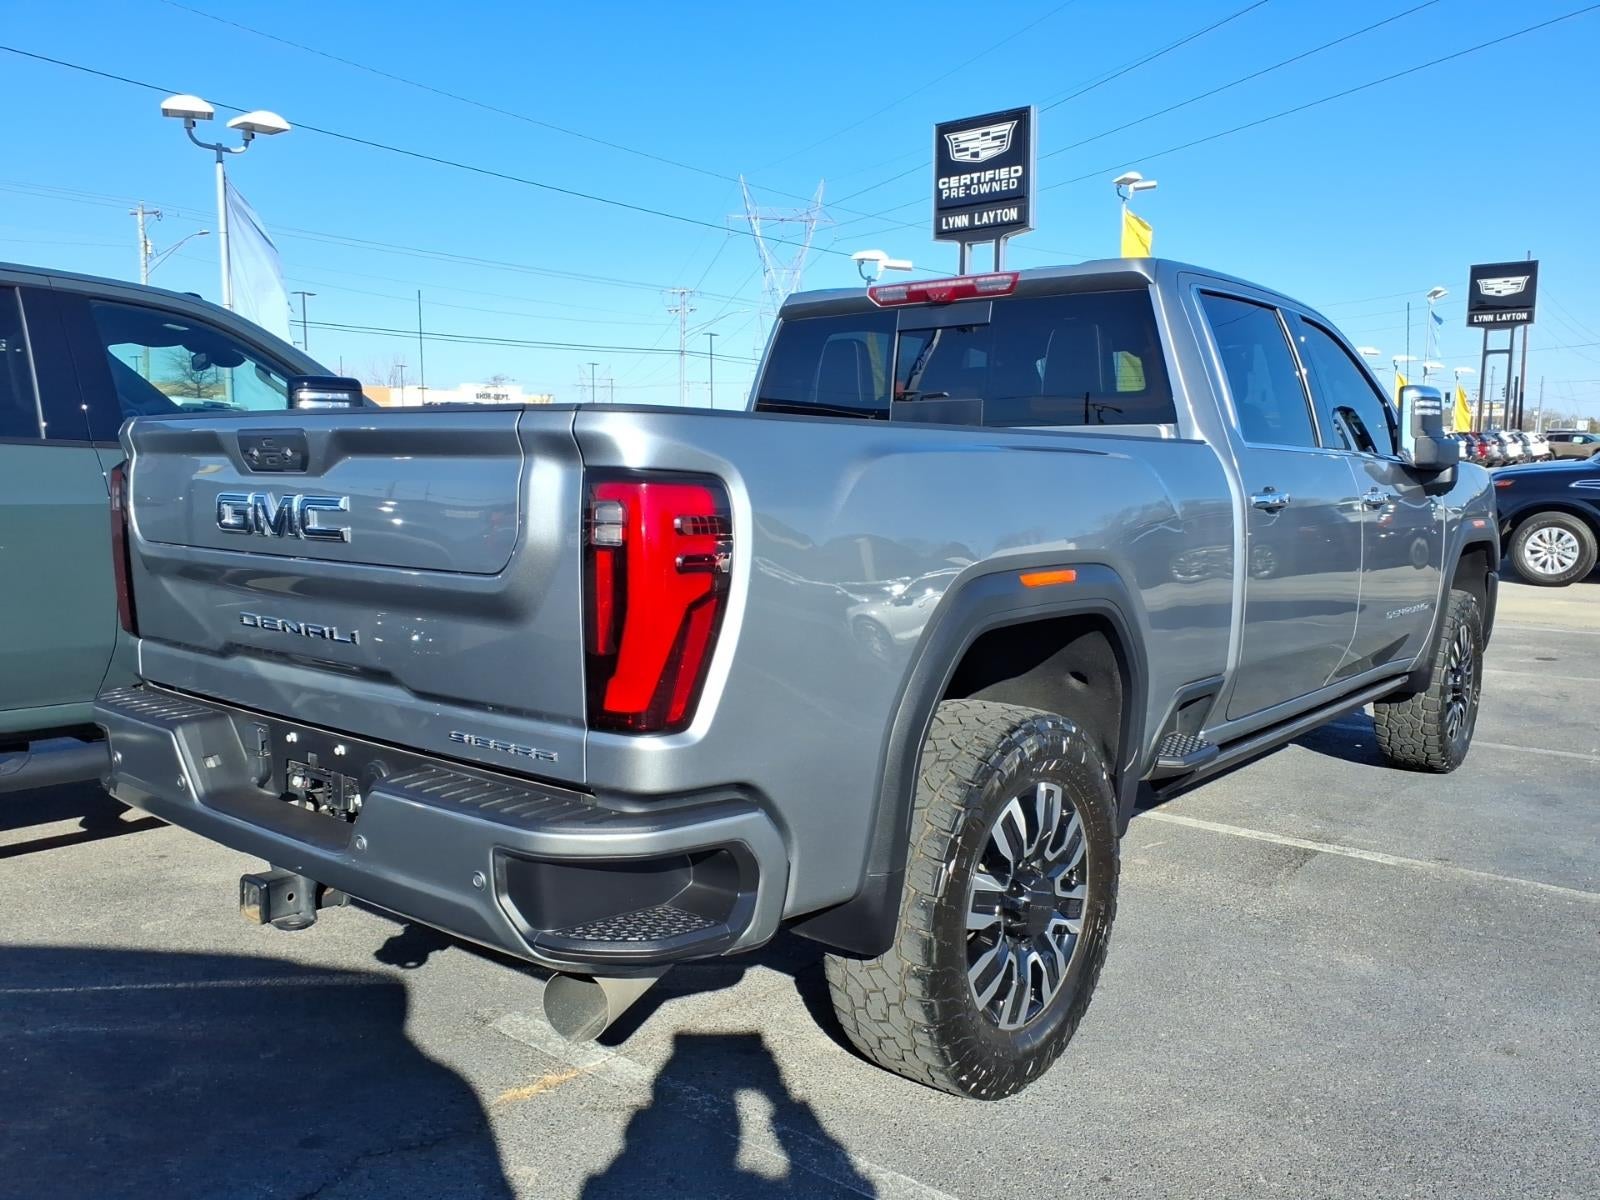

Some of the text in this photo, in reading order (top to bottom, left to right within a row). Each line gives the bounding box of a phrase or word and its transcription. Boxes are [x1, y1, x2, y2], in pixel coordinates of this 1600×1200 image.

[938, 165, 1023, 189] CERTIFIED
[942, 178, 1018, 200] PRE-OWNED
[942, 207, 1018, 229] LYNN LAYTON
[1473, 312, 1528, 323] LYNN LAYTON
[216, 492, 352, 544] GMC
[239, 611, 361, 646] DENALI
[448, 730, 559, 761] SIERRA
